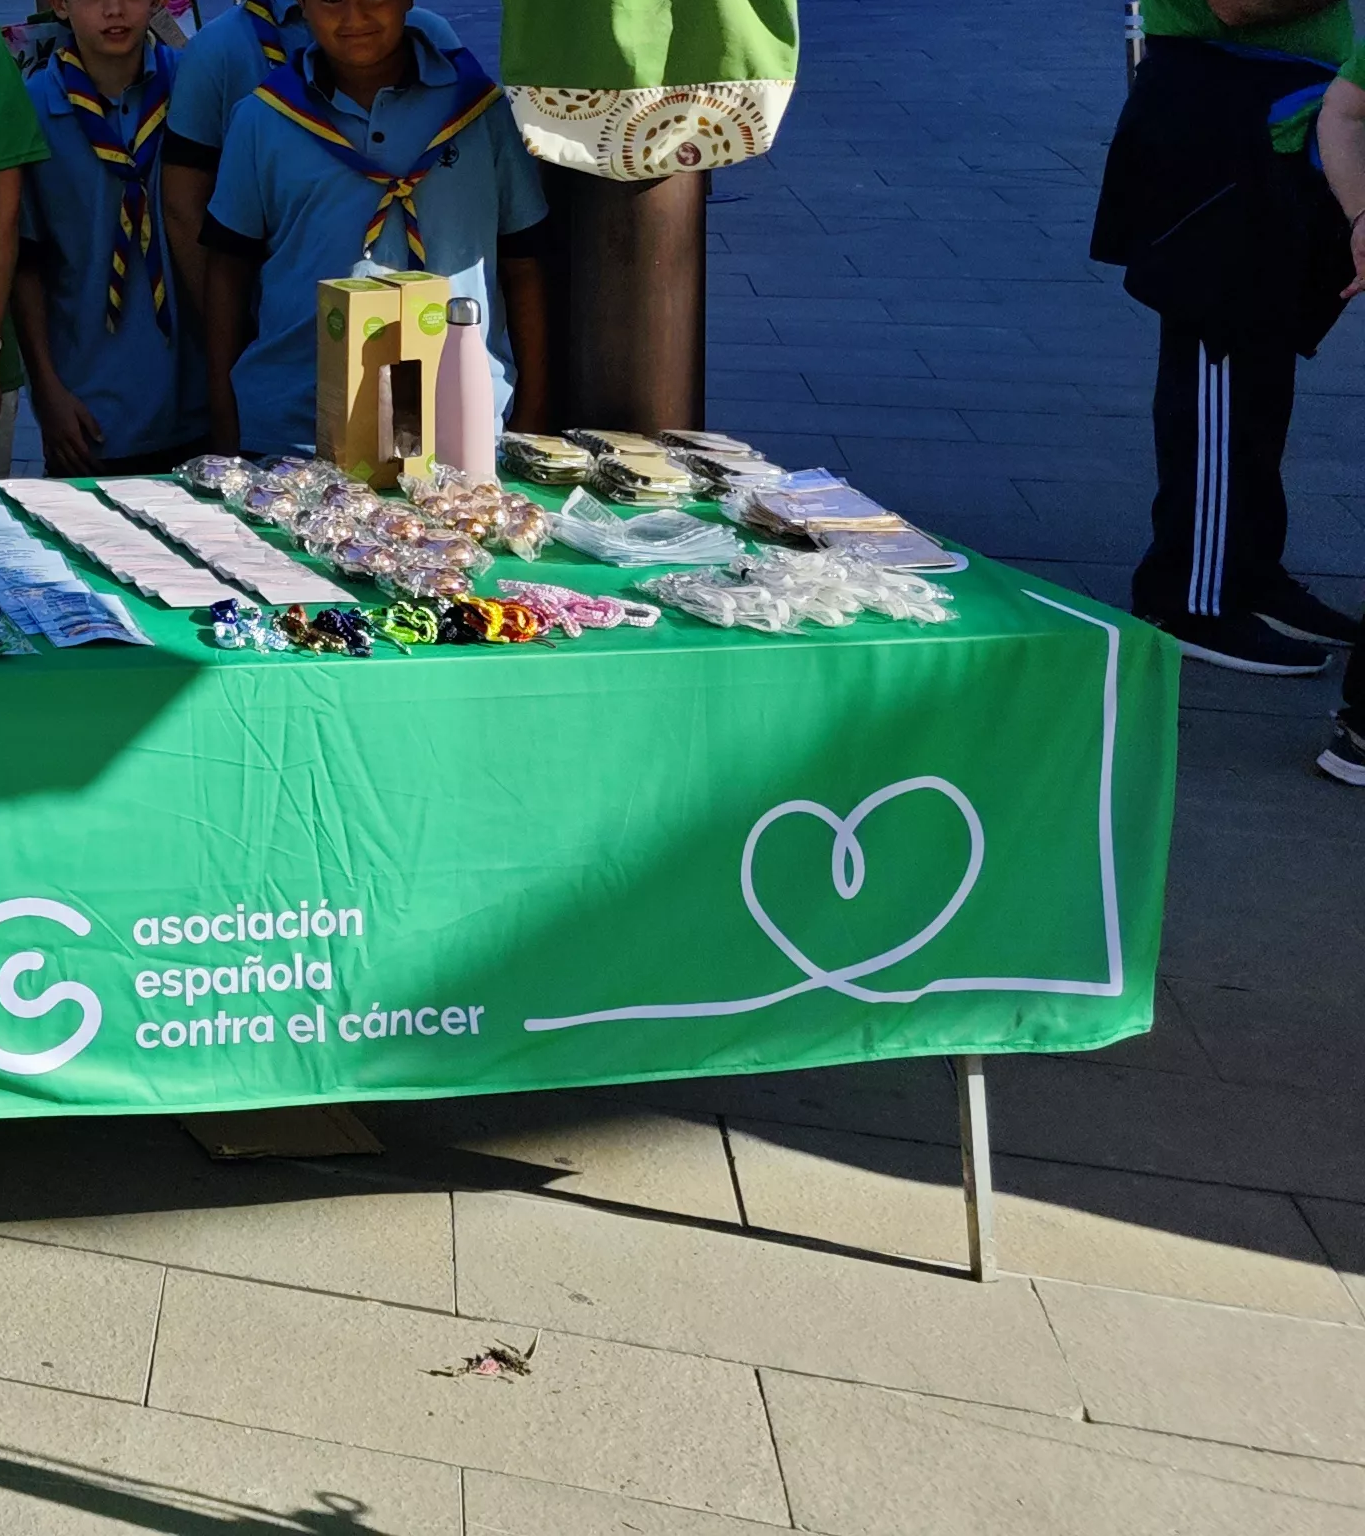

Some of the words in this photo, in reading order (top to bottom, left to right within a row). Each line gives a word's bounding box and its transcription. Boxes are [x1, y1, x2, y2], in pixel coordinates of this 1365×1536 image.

[132, 898, 364, 946] asociación
[134, 953, 333, 1006] española
[135, 1010, 275, 1049] contra
[287, 1005, 326, 1044] el
[338, 1001, 486, 1042] cáncer
